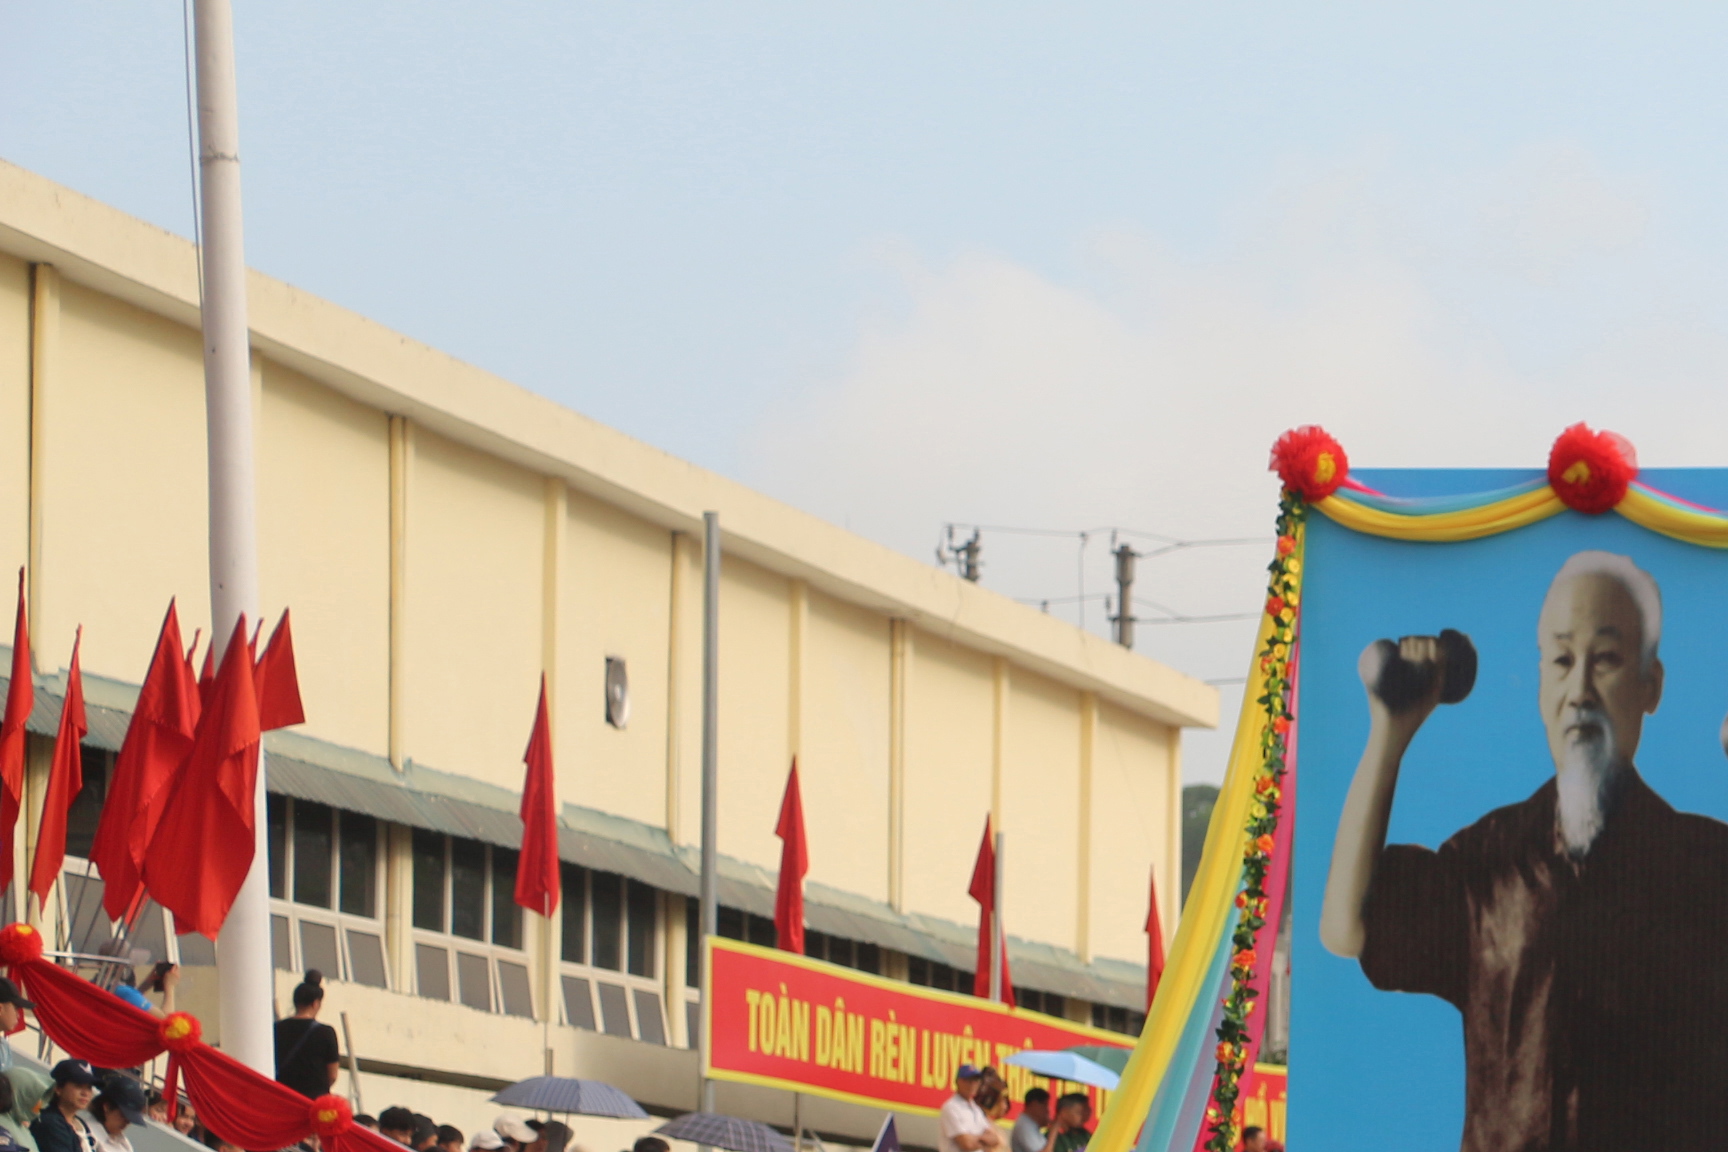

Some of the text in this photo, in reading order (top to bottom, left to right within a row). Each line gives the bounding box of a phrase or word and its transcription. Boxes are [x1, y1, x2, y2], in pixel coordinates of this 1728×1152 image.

[746, 982, 810, 1062] TOÀN
[815, 996, 865, 1075] DÂN
[869, 1009, 917, 1086] RÈN
